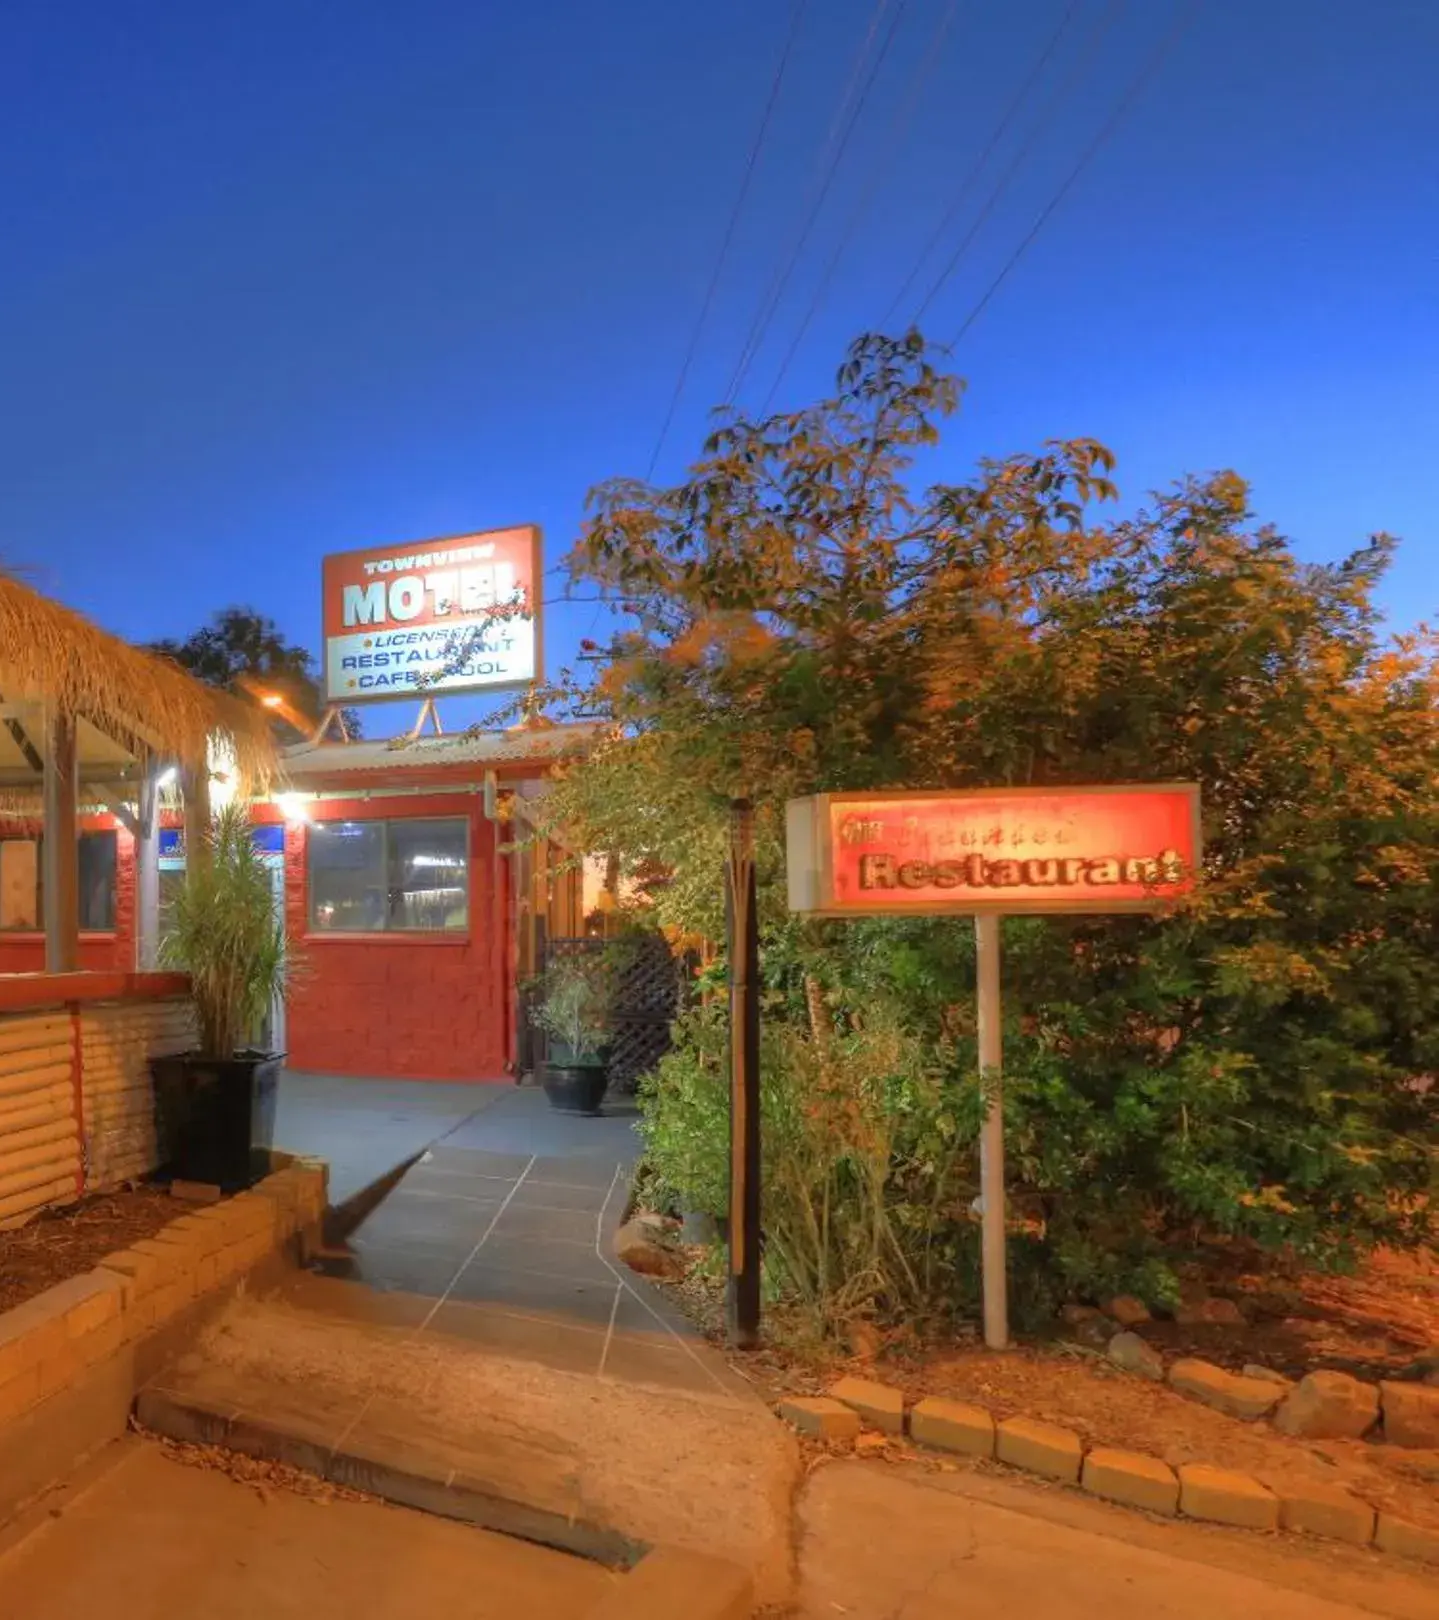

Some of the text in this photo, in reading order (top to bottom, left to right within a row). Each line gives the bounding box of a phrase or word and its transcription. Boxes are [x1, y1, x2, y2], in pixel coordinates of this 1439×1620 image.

[342, 561, 526, 627] MOTEL
[444, 661, 508, 677] OOL
[859, 848, 1184, 889] Restaurant
